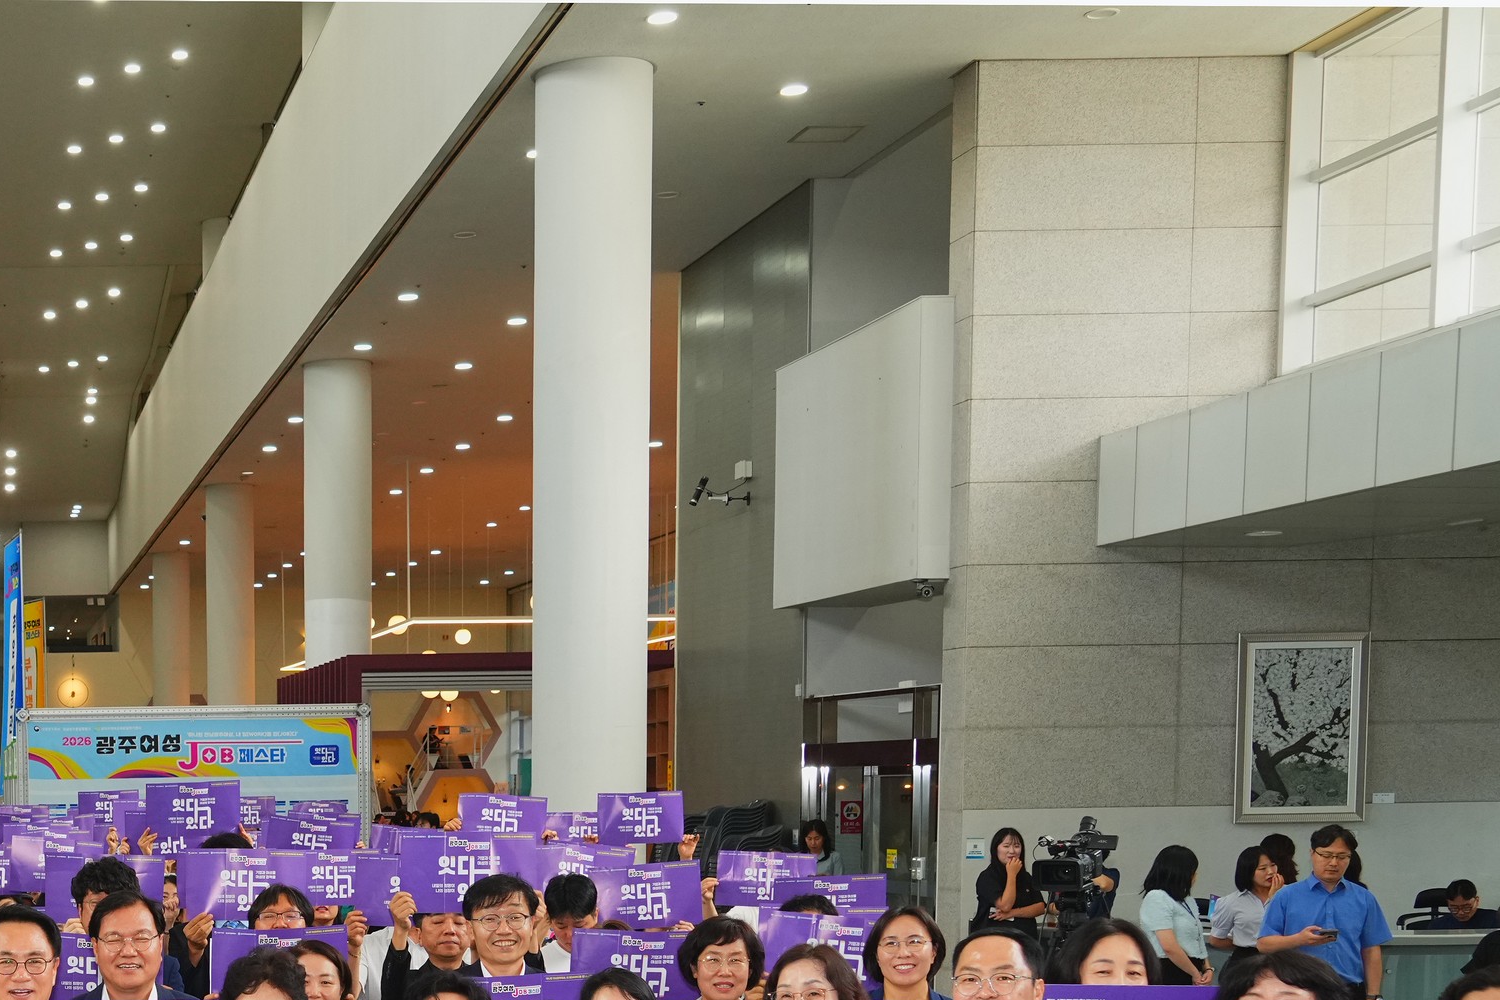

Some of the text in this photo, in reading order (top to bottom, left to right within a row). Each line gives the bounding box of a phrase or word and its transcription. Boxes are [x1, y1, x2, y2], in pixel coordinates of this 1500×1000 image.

[62, 736, 91, 746] 2026
[95, 733, 181, 754] 광주여성
[178, 741, 286, 771] JOB 페스타
[172, 798, 201, 812] 잇다
[186, 814, 214, 830] 있다
[622, 807, 646, 822] 잇다
